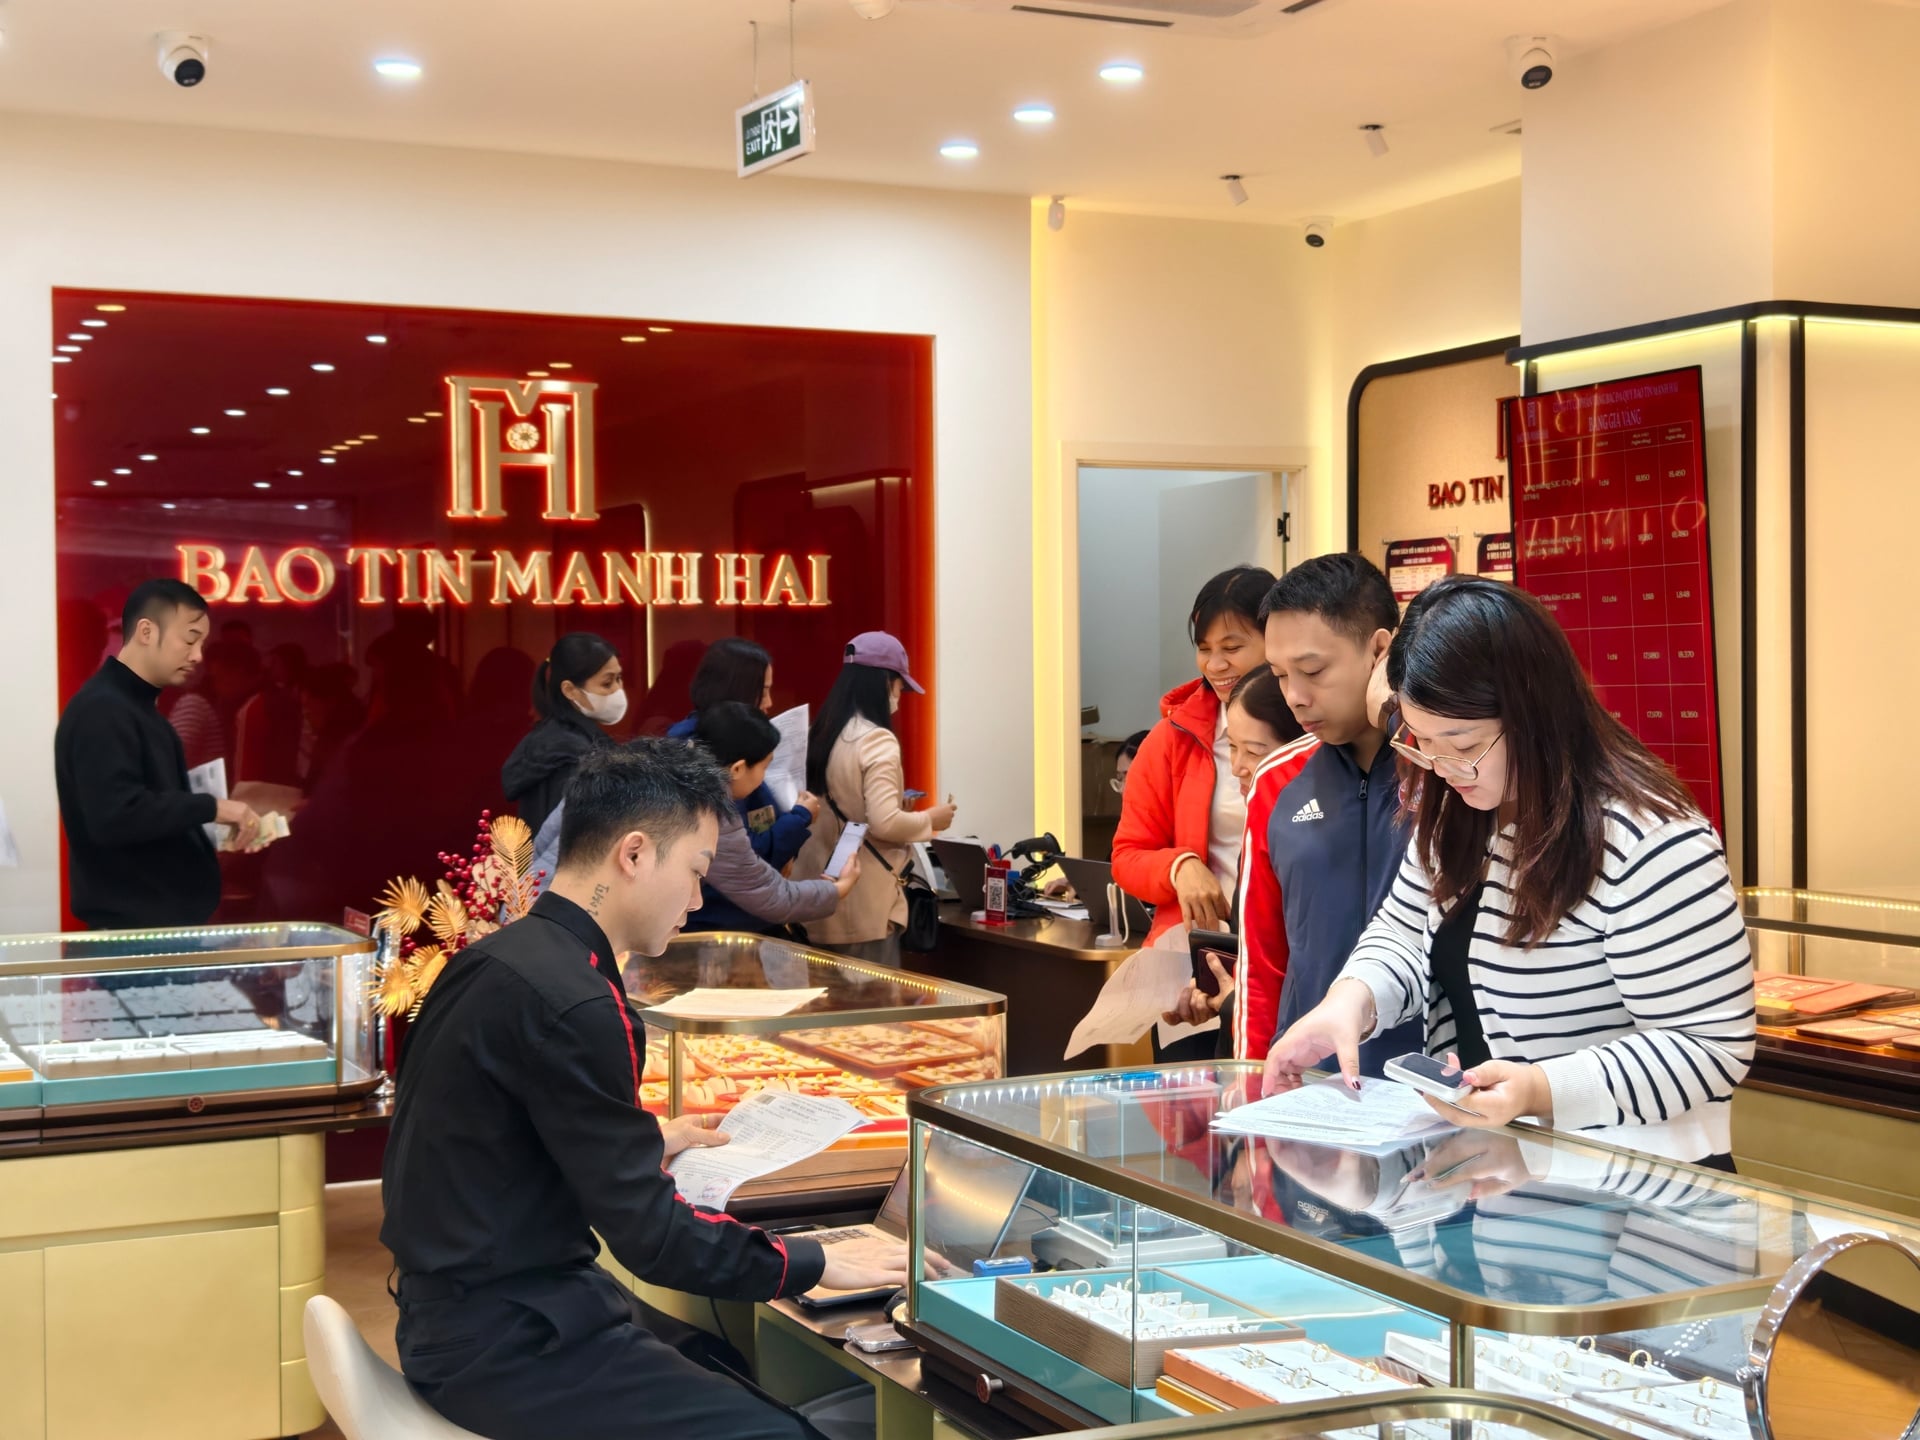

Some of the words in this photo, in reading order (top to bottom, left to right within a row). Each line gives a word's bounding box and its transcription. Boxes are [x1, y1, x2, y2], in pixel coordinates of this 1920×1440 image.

[746, 138, 760, 155] EXIT
[1428, 480, 1465, 508] BAO
[1469, 475, 1504, 503] TIN
[176, 545, 335, 602] BAO
[347, 548, 475, 603] TIN
[490, 551, 702, 604] MANH
[715, 553, 832, 606] HAI
[1292, 811, 1324, 823] adidas
